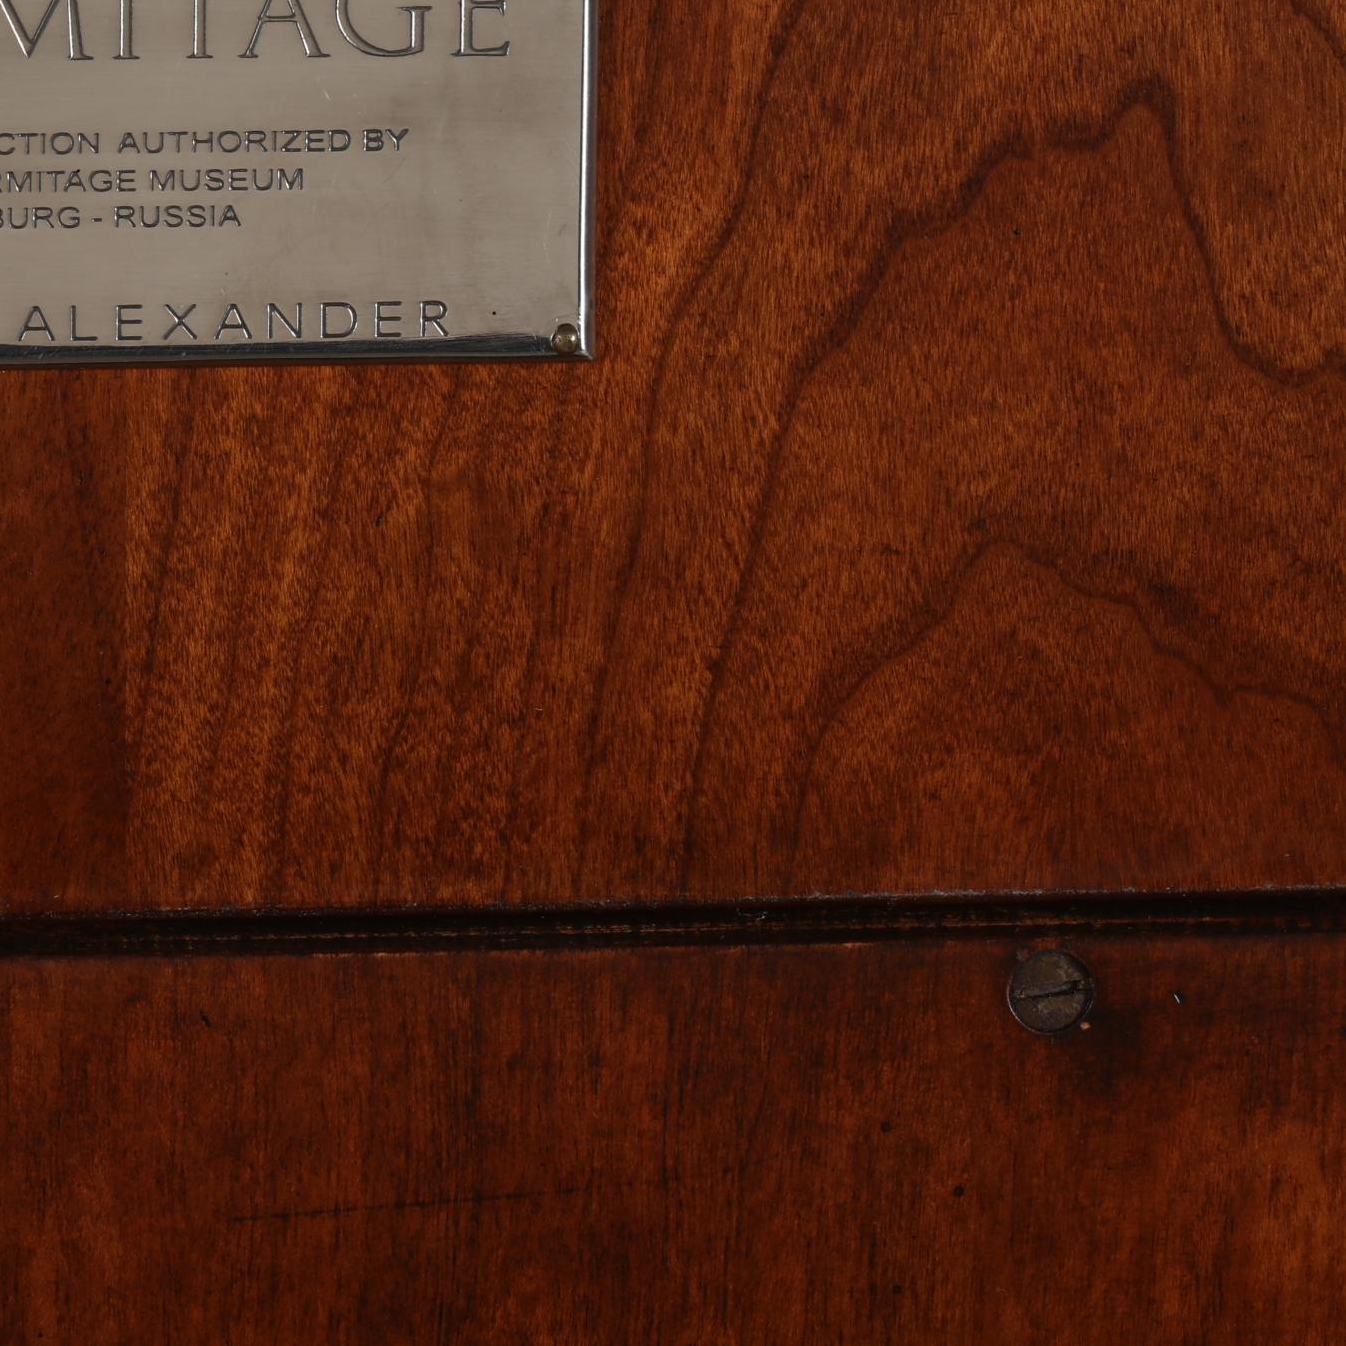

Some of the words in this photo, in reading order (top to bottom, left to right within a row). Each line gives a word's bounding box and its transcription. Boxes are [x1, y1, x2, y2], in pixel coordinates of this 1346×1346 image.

[117, 130, 352, 156] AUTHORIZED
[364, 128, 409, 154] BY
[150, 167, 305, 194] MUSEUM
[114, 204, 242, 231] RUSSIA
[19, 300, 451, 344] ALEXANDER
